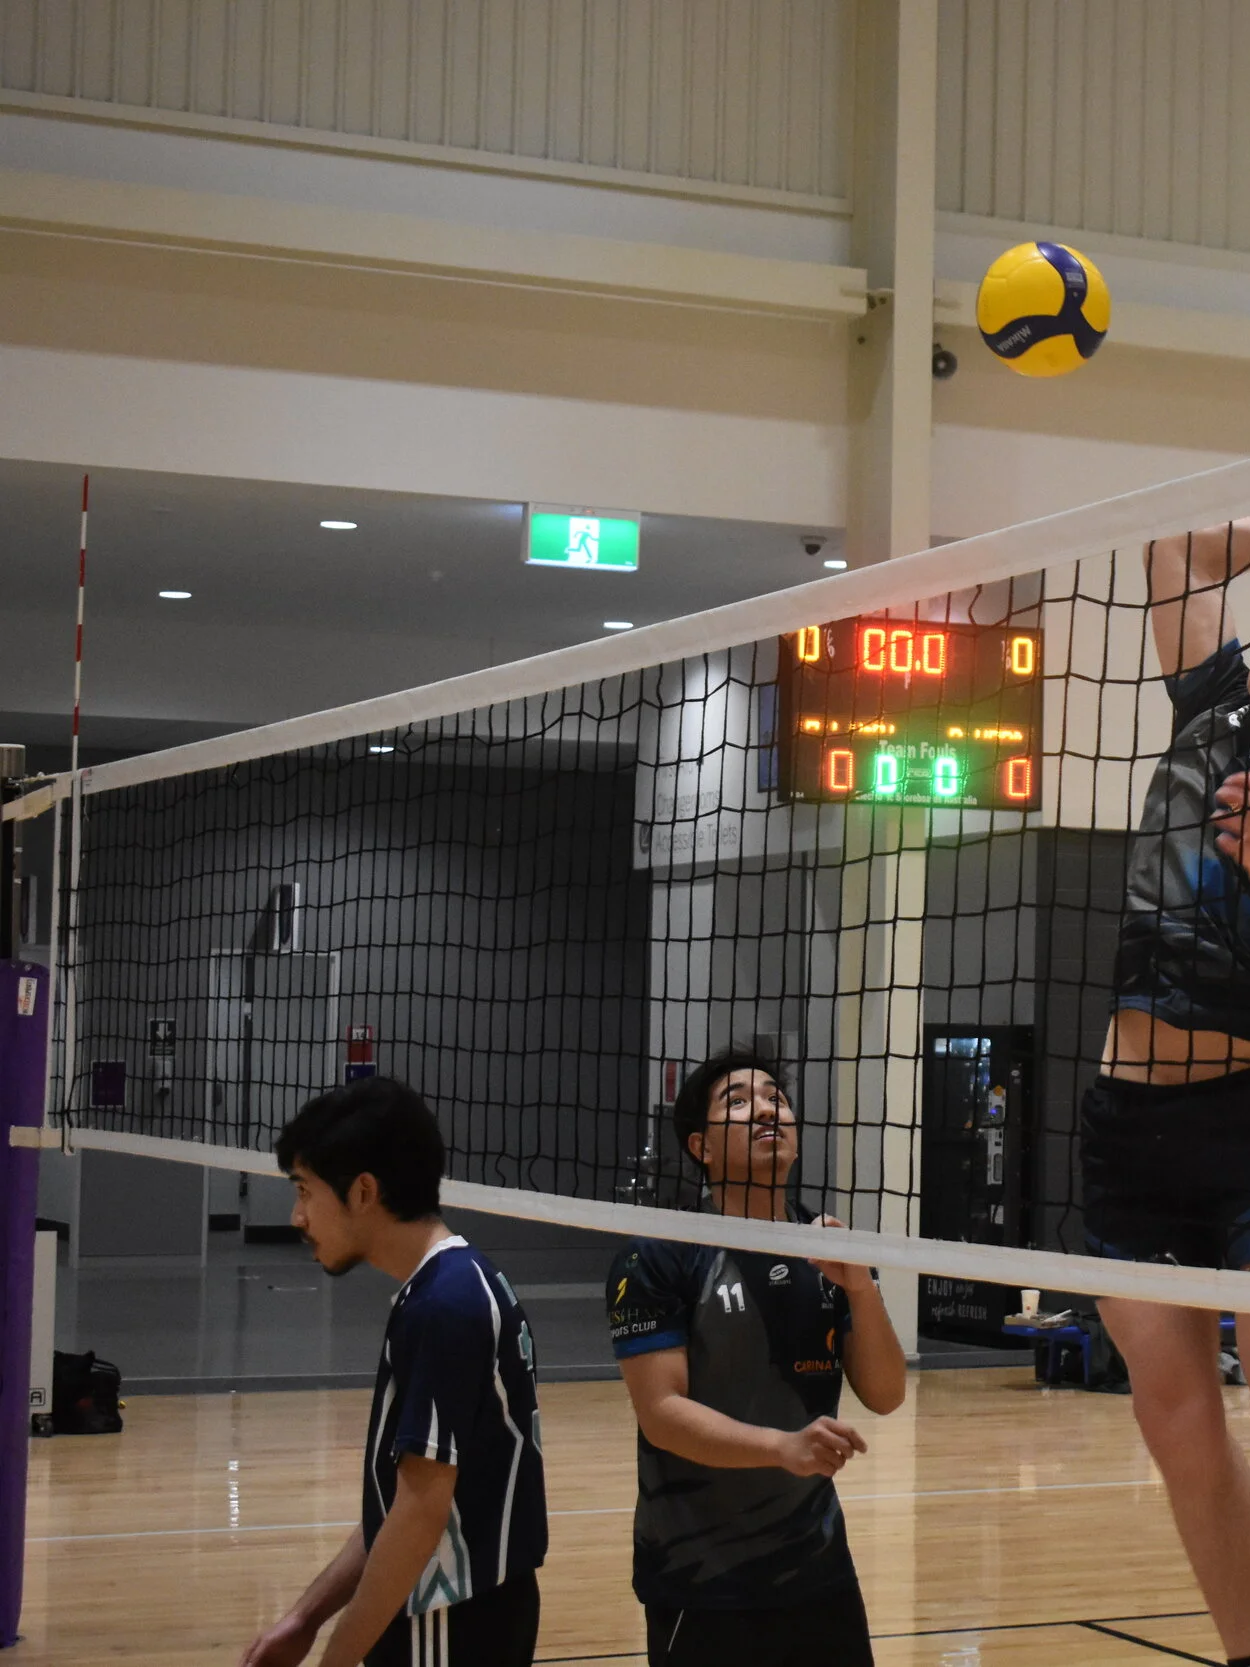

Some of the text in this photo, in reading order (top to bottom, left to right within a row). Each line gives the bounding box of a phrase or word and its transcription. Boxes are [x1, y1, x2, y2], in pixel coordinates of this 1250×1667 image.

[799, 625, 820, 661] 0
[1012, 637, 1033, 674] 0
[879, 741, 957, 759] Team Fouls
[830, 750, 854, 791] 0
[876, 755, 897, 794] 0
[935, 757, 958, 796] 0
[1008, 758, 1031, 798] 0
[706, 823, 738, 847] Tolets
[716, 1281, 746, 1314] 11
[927, 1277, 953, 1297] ENJOY
[631, 1320, 657, 1334] CLUB
[793, 1359, 833, 1373] CARINA
